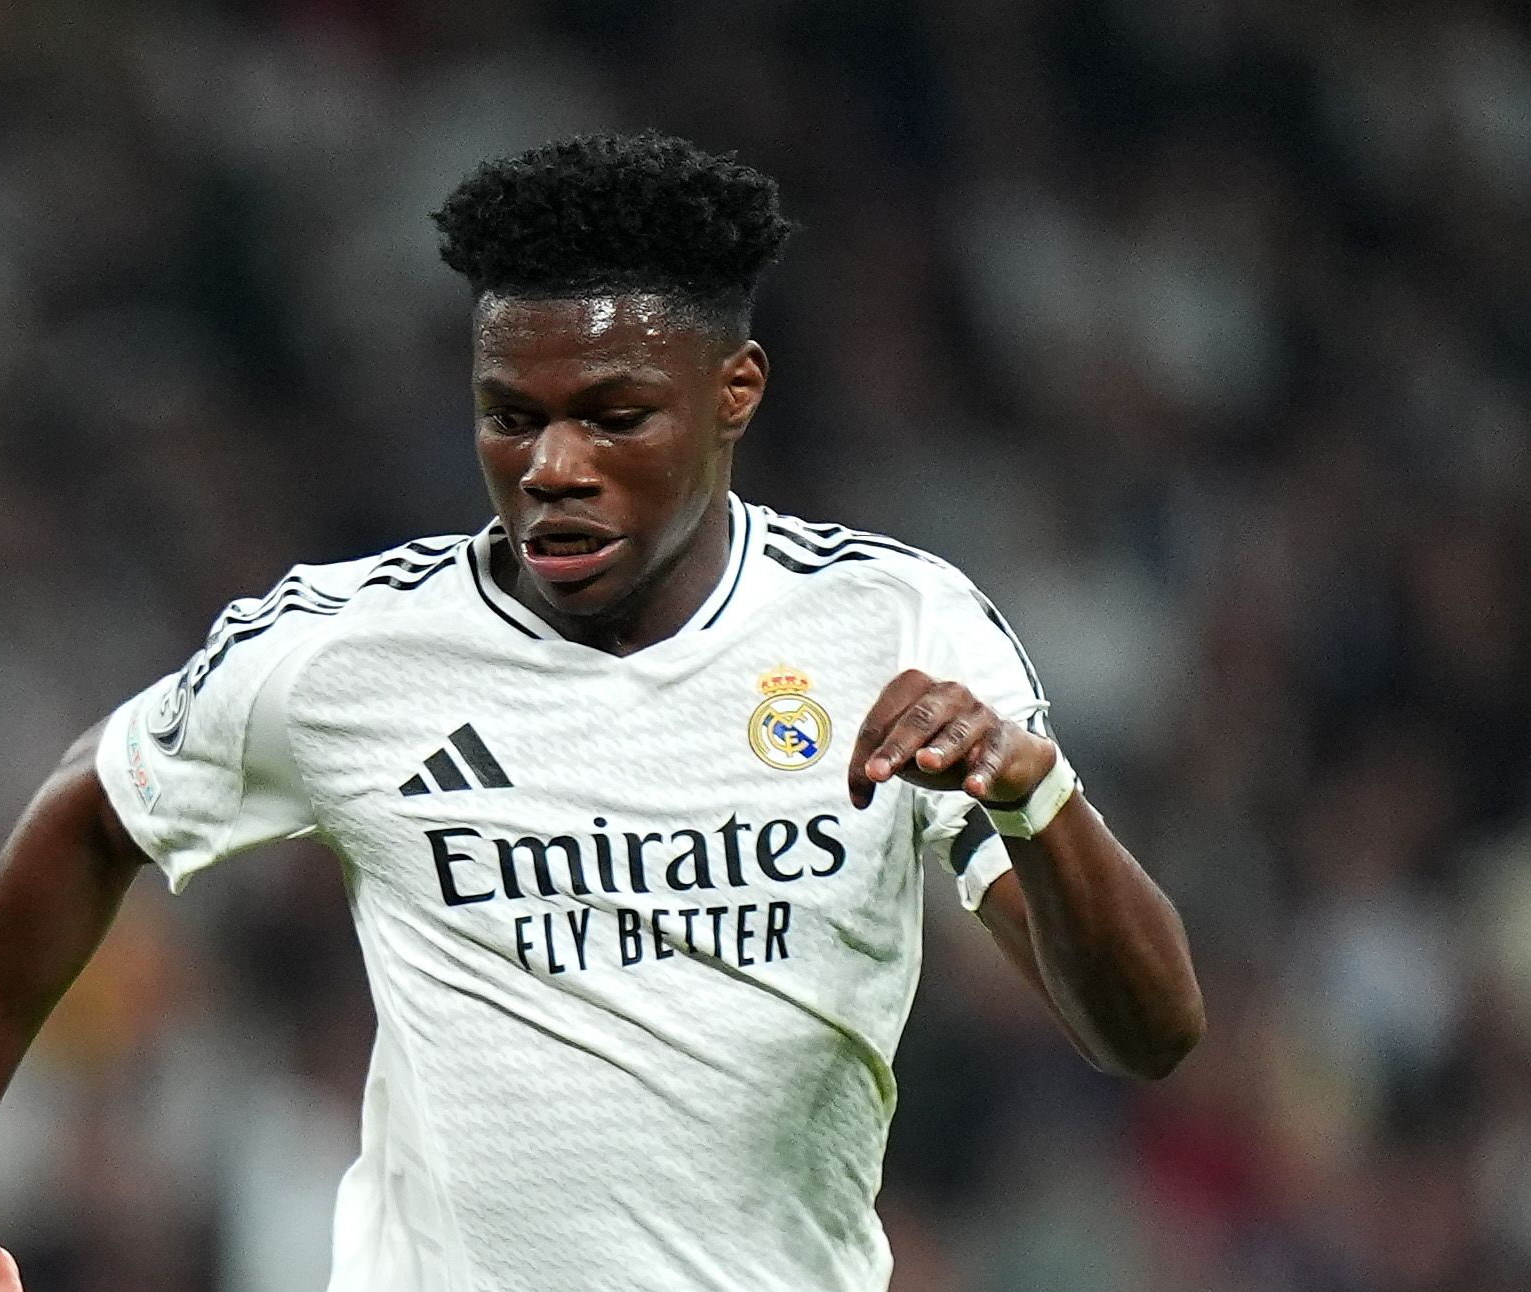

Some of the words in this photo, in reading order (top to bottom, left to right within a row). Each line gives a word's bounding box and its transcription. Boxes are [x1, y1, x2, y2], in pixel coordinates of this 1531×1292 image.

[423, 810, 847, 905] Emirates
[515, 907, 592, 975] FLY
[617, 901, 792, 967] BETTER
